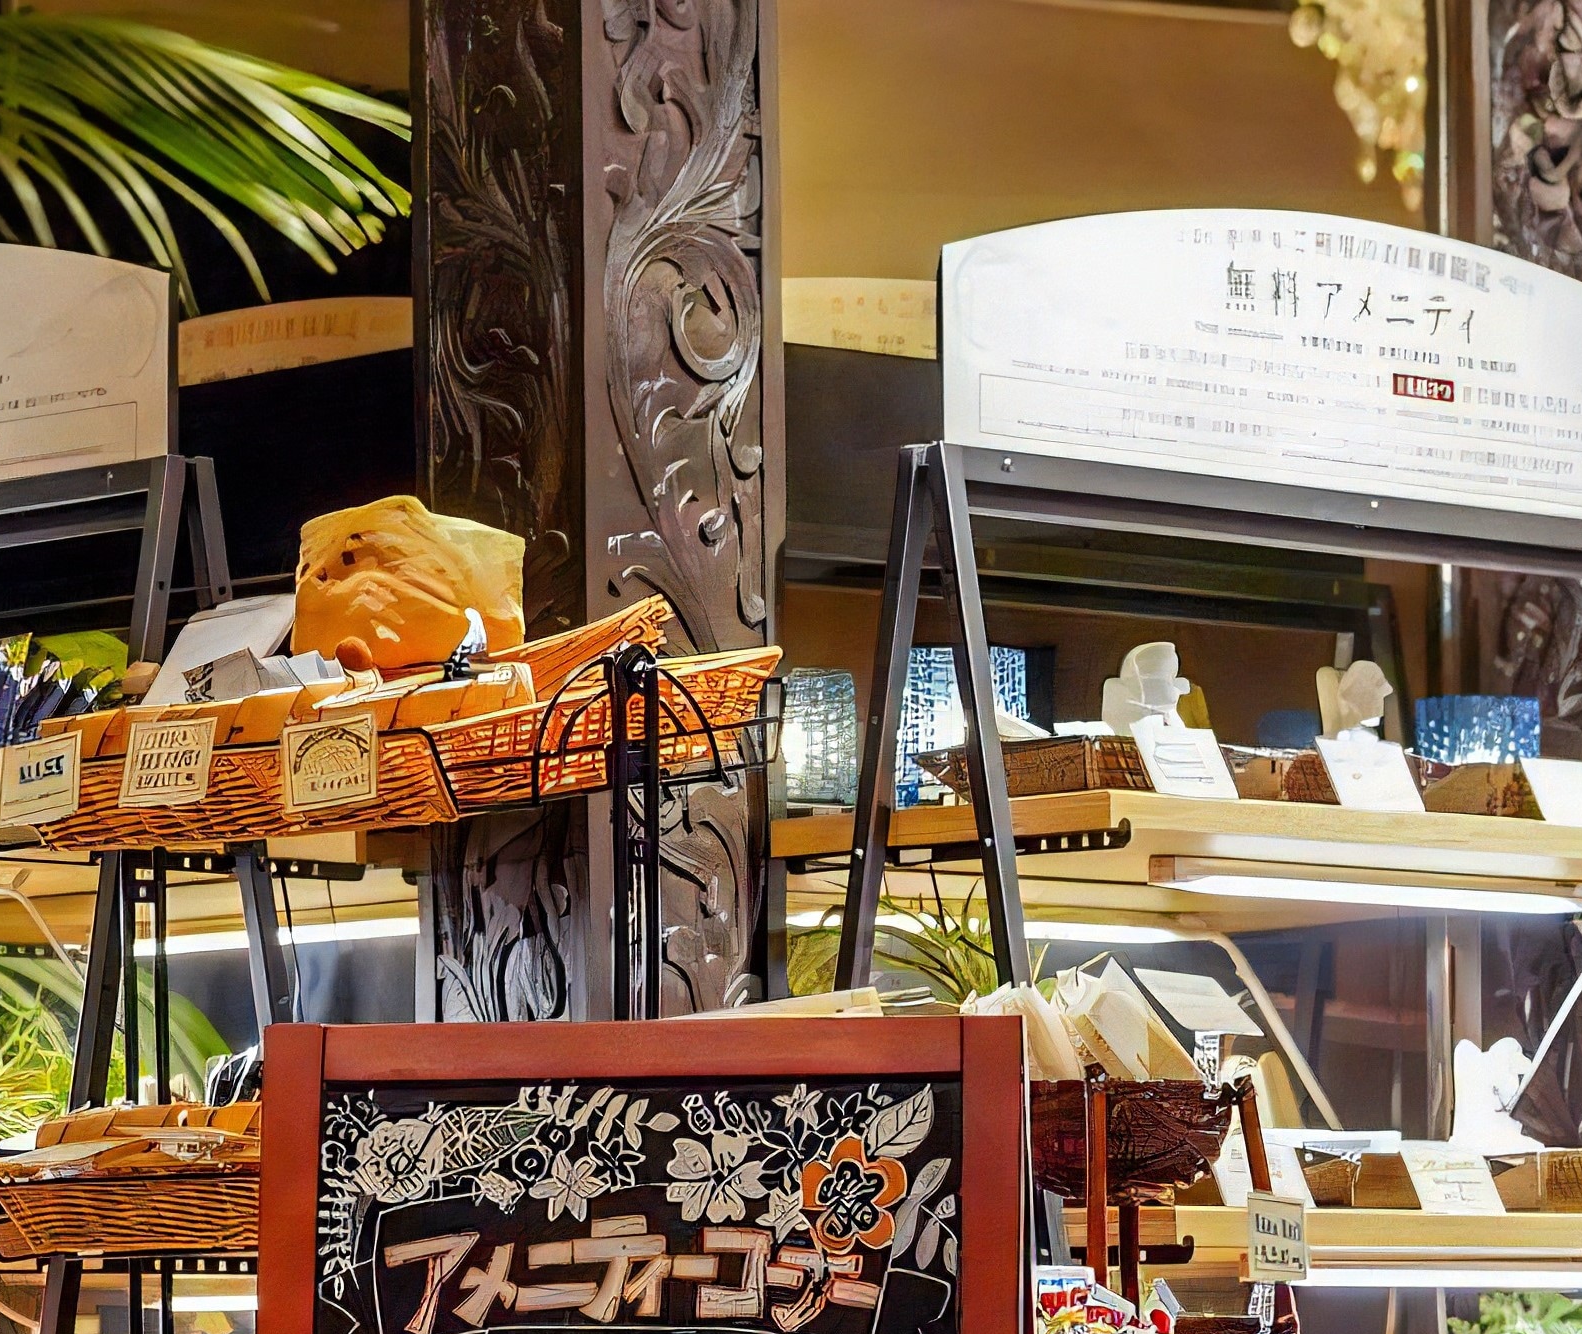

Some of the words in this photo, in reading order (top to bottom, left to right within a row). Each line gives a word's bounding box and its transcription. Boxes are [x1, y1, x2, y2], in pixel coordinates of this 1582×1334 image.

[1225, 260, 1475, 345] 無料アメニティ
